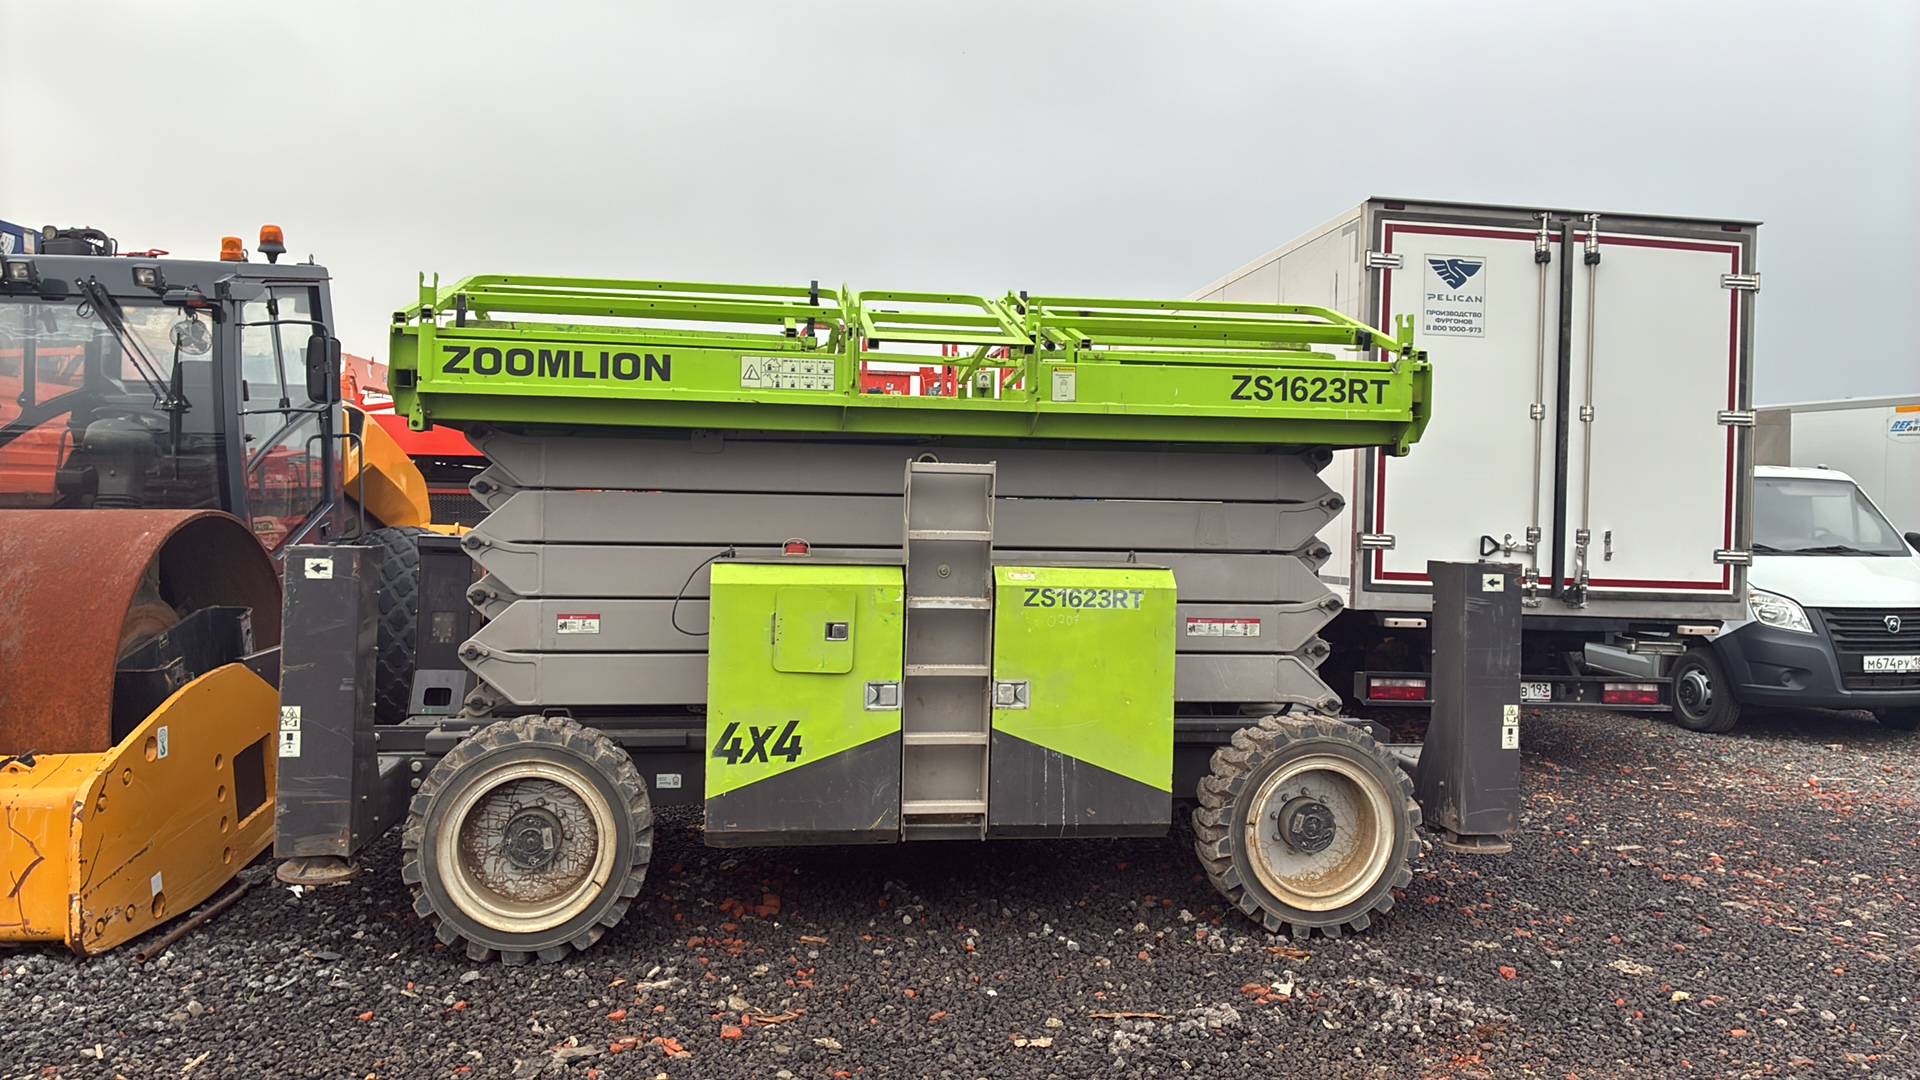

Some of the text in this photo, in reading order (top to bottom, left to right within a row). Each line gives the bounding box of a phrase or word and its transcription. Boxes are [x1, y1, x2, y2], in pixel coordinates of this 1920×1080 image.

[1426, 293, 1482, 303] PELICAN
[1426, 309, 1482, 318] ПРОИЗВОДСТВО
[1435, 317, 1473, 325] ФУРГОНОВ
[442, 345, 672, 382] ZOOMLION
[1230, 374, 1390, 404] ZS1623RT
[1023, 588, 1144, 608] ZS1623RT
[1530, 683, 1549, 696] 193
